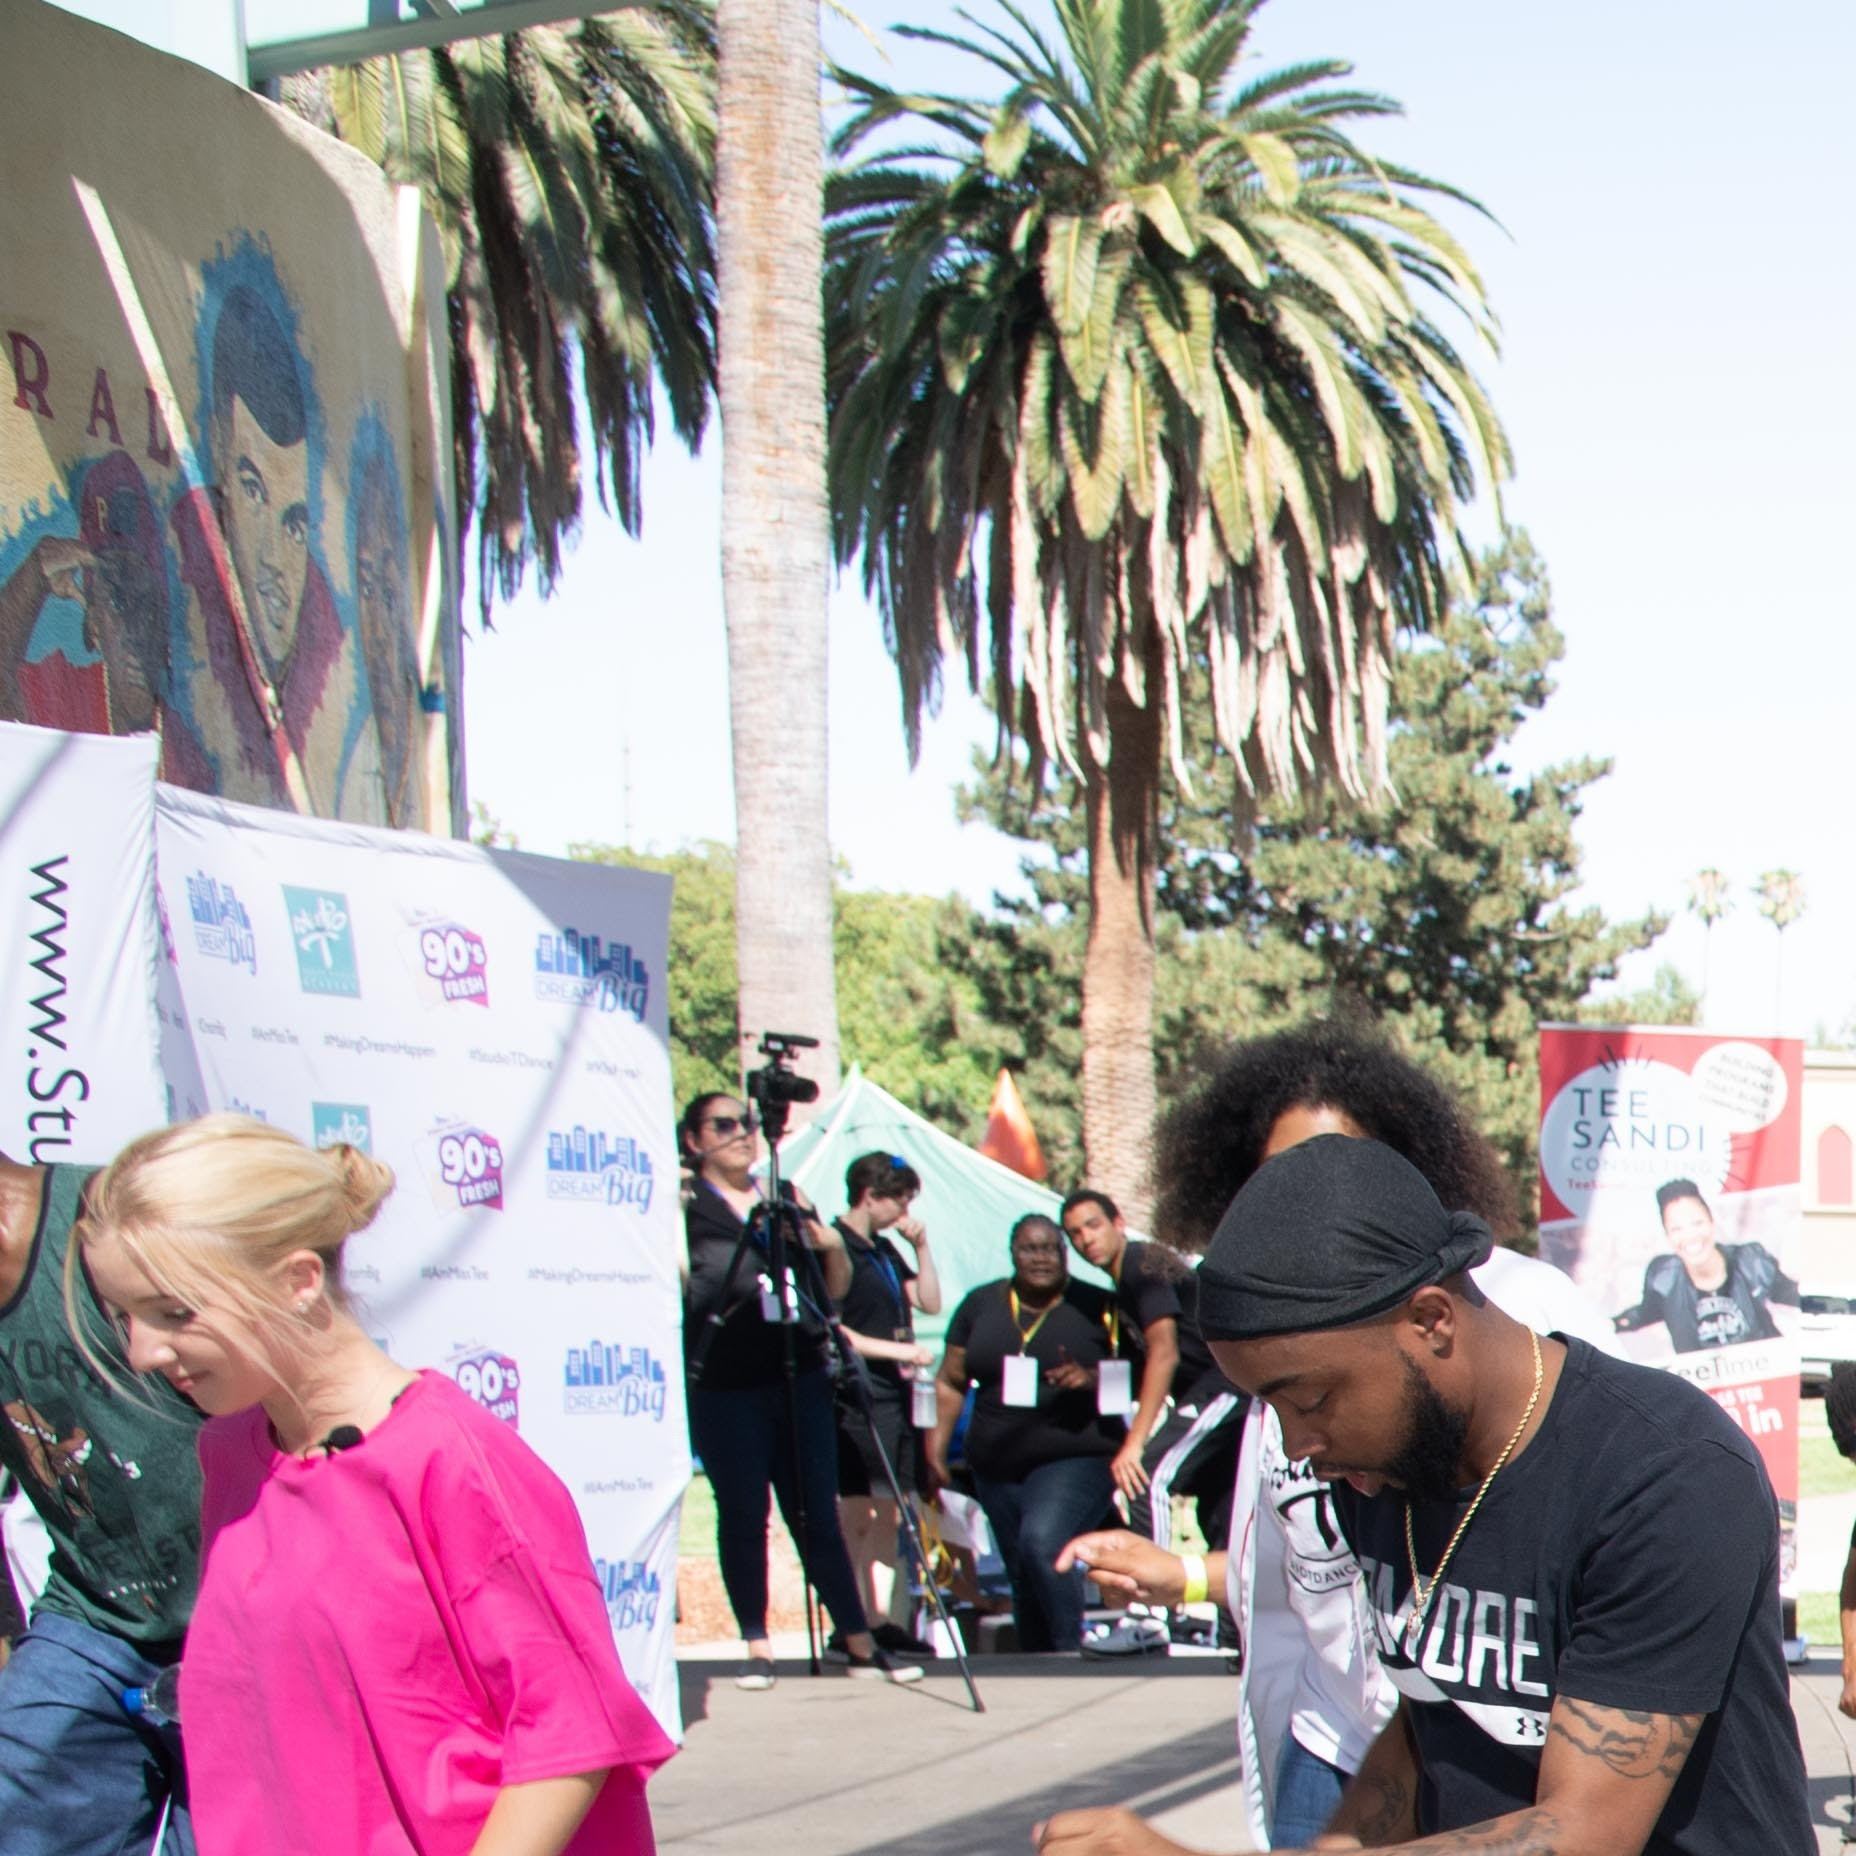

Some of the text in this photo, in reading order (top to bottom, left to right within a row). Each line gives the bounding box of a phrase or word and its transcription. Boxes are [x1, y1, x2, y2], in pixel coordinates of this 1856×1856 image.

[28, 854, 90, 1166] www.Stu
[1573, 1088, 1649, 1119] TEE
[1572, 1120, 1704, 1151] SANDI
[602, 1164, 654, 1214] Big
[617, 1375, 667, 1422] Big
